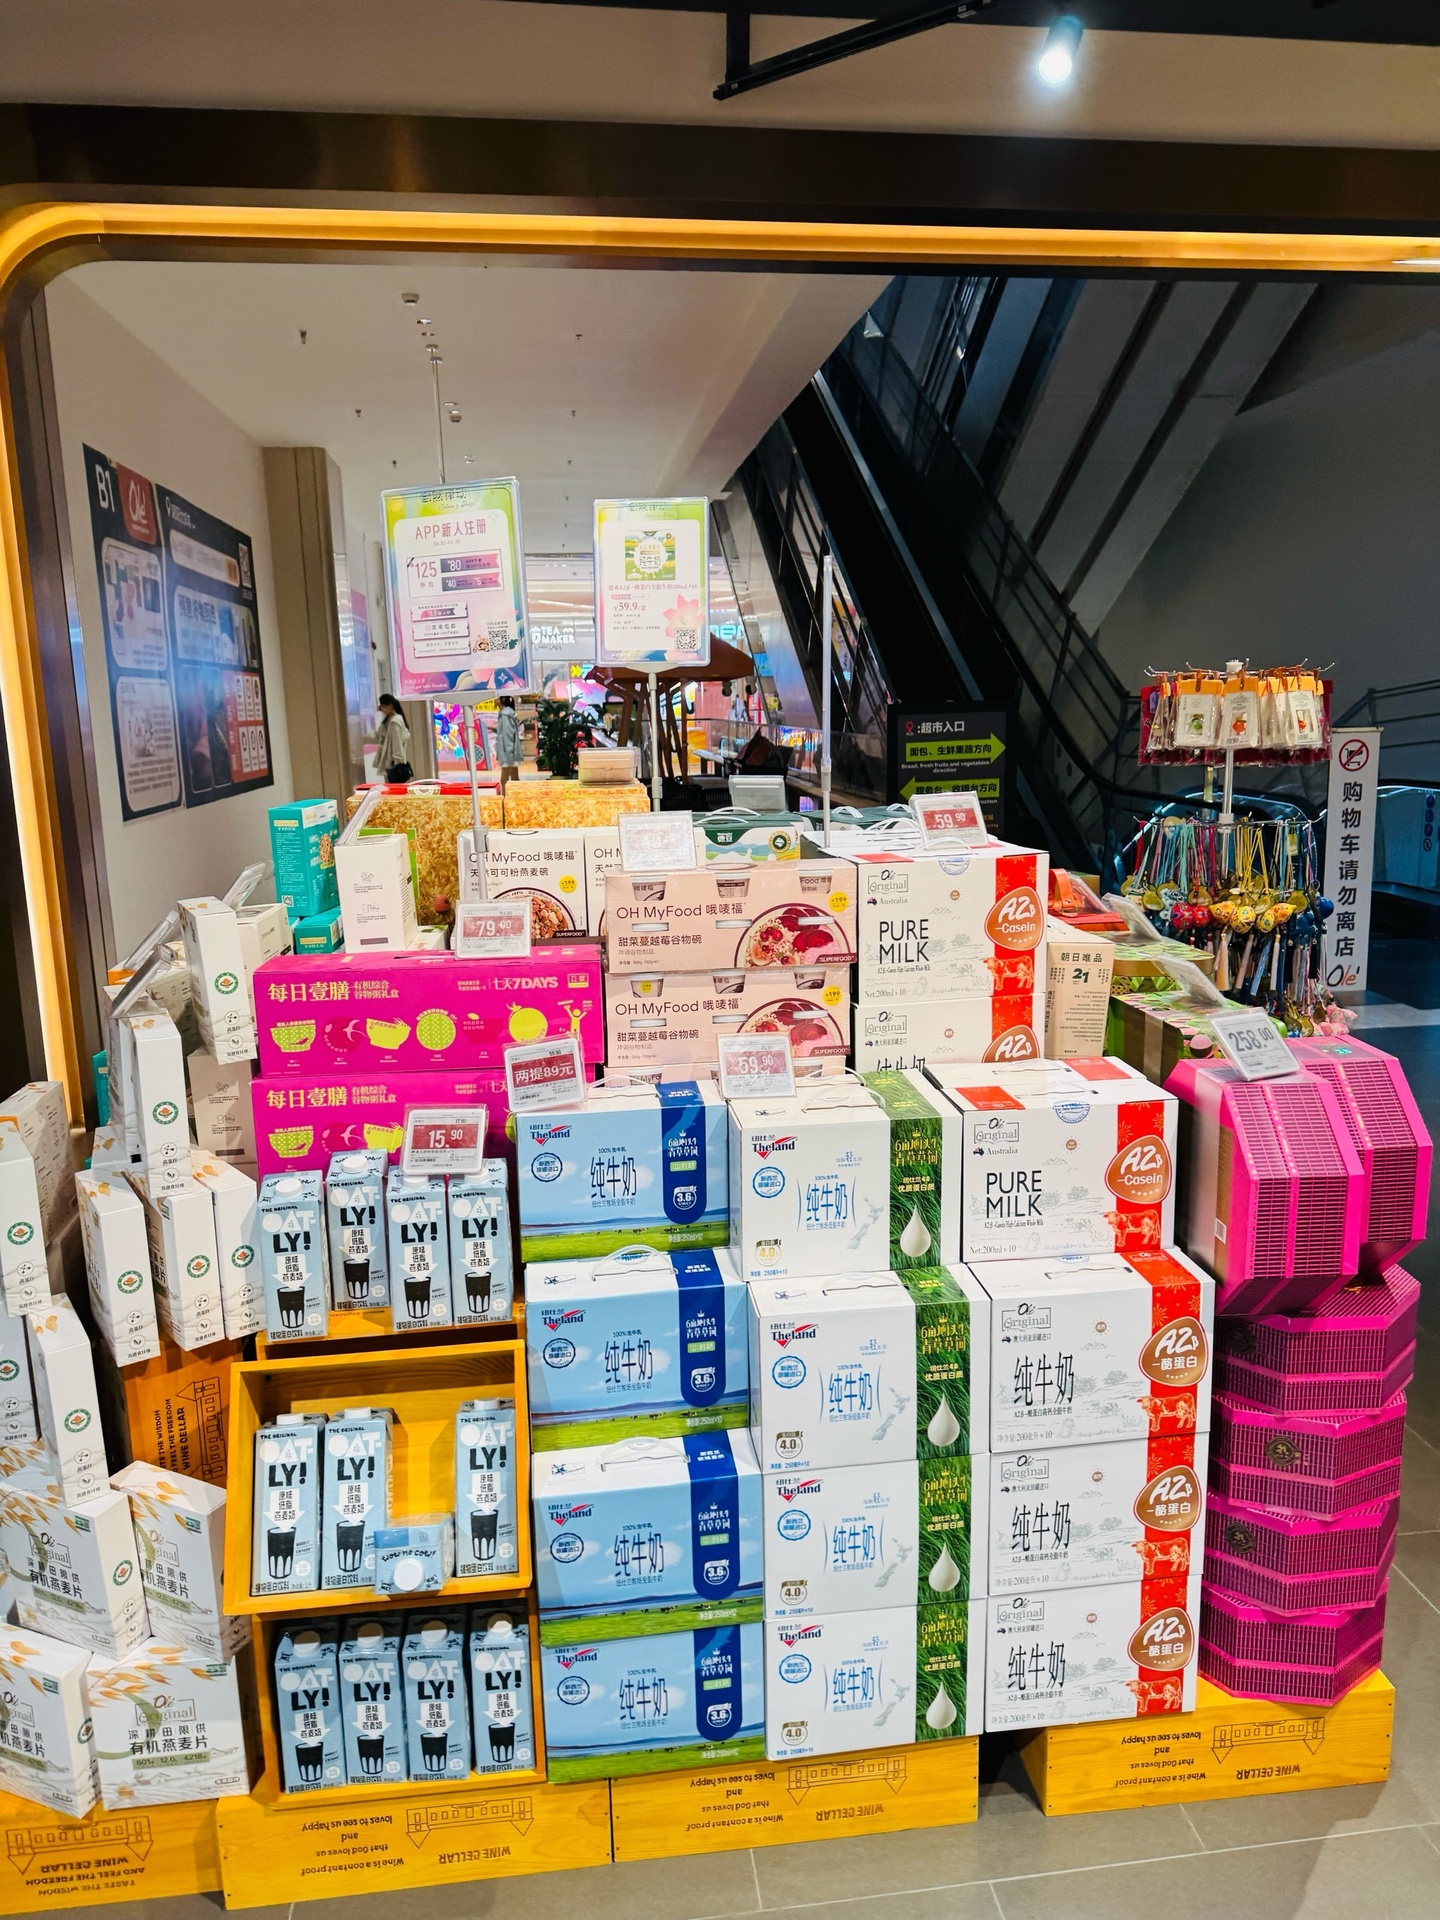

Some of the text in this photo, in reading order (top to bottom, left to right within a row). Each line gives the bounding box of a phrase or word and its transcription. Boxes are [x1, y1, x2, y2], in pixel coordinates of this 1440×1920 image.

[96, 464, 115, 512] B1
[415, 519, 486, 540] APP新人注册
[415, 562, 437, 578] 125
[541, 626, 561, 635] TEA
[541, 634, 576, 644] MAKER
[910, 744, 992, 757] 面包、生鲜果蔬方向
[492, 852, 540, 864] MyFood
[544, 851, 575, 861] 哦唛福
[1335, 781, 1363, 958] 购物车请勿离店
[879, 897, 908, 905] Australia
[616, 903, 743, 921] OH MyFood 哦唛福
[879, 919, 929, 942] PURE
[618, 934, 702, 947] 甜菜蔓越莓谷物碗
[879, 942, 929, 964] MILK
[1061, 953, 1102, 962] 朝日唯品
[354, 980, 390, 990] 有机综合
[493, 976, 558, 990] 七天7DAYS
[1072, 968, 1089, 983] 21
[268, 981, 351, 1002] 每日壹膳
[354, 989, 399, 999] 谷物粥礼盒
[615, 998, 739, 1016] OH MyFood 哦唛福
[617, 1029, 699, 1042] 甜菜蔓越莓谷物碗
[1228, 1027, 1274, 1051] 258.00
[515, 1062, 573, 1083] 两提89元
[266, 1087, 348, 1109] 每日壹膳
[352, 1085, 388, 1096] 有机综合
[352, 1094, 397, 1105] 谷物粥礼盒
[429, 1129, 463, 1148] 15.90
[530, 1129, 571, 1139] Theland
[752, 1141, 795, 1153] Theland
[986, 1147, 1018, 1156] Australia
[590, 1155, 637, 1198] 纯牛奶
[986, 1170, 1042, 1195] PURE
[677, 1193, 692, 1202] 3.6
[806, 1183, 848, 1222] 纯牛奶
[986, 1194, 1043, 1219] MILK
[340, 1205, 376, 1226] LY!
[401, 1222, 438, 1243] LY!
[462, 1217, 498, 1238] LY!
[273, 1231, 311, 1254] LY!
[542, 1314, 584, 1324] Theland
[770, 1329, 816, 1341] Theland
[605, 1339, 653, 1383] 纯牛奶
[1014, 1351, 1074, 1406] 纯牛奶
[829, 1372, 872, 1413] 纯牛奶
[156, 1410, 164, 1440] WISDOM
[165, 1399, 175, 1439] FREEDOM
[177, 1407, 191, 1469] WINE CELLAR
[469, 1446, 507, 1470] LY!
[268, 1463, 307, 1487] LY!
[337, 1456, 375, 1481] LY!
[776, 1484, 821, 1496] Theland
[549, 1508, 592, 1520] Theland
[1011, 1500, 1071, 1551] 纯牛奶
[833, 1524, 875, 1563] 纯牛奶
[614, 1532, 664, 1577] 纯牛奶
[29, 1569, 82, 1599] 有机燕麦片
[556, 1652, 598, 1664] Theland
[1007, 1641, 1066, 1691] 纯牛奶
[417, 1680, 455, 1700] LY!
[485, 1670, 522, 1691] LY!
[833, 1666, 874, 1704] 纯牛奶
[291, 1688, 330, 1711] LY!
[353, 1681, 391, 1702] LY!
[620, 1677, 669, 1720] 纯牛奶
[129, 1735, 208, 1755] 有机燕麦片
[1121, 1737, 1145, 1745] happy
[1154, 1747, 1170, 1756] and
[1162, 1760, 1176, 1768] God
[1236, 1764, 1300, 1781] WINE CELLAR
[690, 1778, 716, 1787] happy
[754, 1772, 775, 1781] loves
[1115, 1777, 1137, 1787] proof
[1187, 1772, 1206, 1780] Wine
[726, 1789, 742, 1798] and
[736, 1802, 750, 1810] God
[753, 1800, 769, 1808] that
[815, 1803, 884, 1822] WINE CELLAR
[341, 1833, 358, 1842] and
[438, 1845, 511, 1864] WINE CELLAR
[41, 1856, 129, 1873] WINE CELLAR
[26, 1867, 145, 1886] AND FEEL THE FREEDOM
[104, 1880, 135, 1888] TASTE
[38, 1886, 79, 1896] WISDOM
